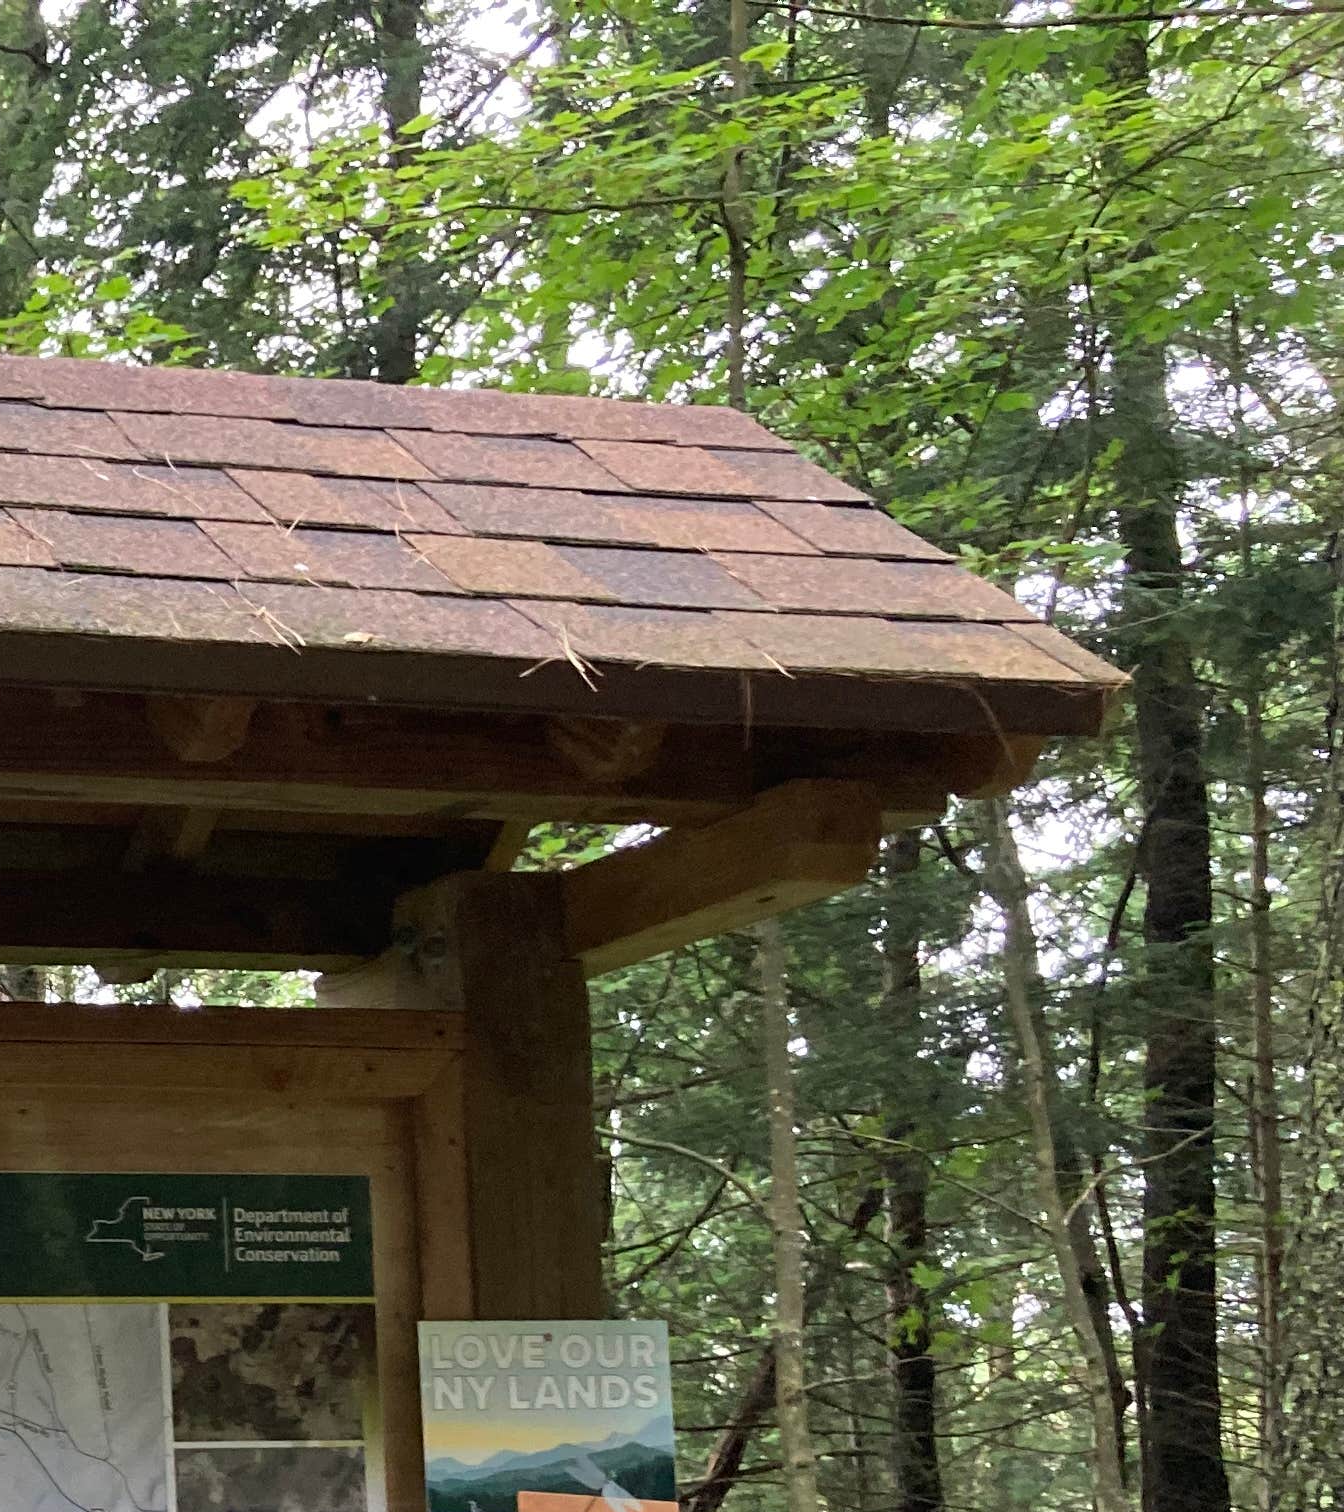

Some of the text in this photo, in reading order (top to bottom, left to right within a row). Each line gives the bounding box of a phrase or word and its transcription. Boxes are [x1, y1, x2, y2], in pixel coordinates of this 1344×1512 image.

[142, 1207, 216, 1220] NEW YORK
[234, 1207, 348, 1226] Department of
[234, 1227, 351, 1242] Environmental
[235, 1248, 340, 1262] Conservation
[431, 1333, 656, 1370] LOVE OUR
[433, 1374, 659, 1411] NY LANDS
